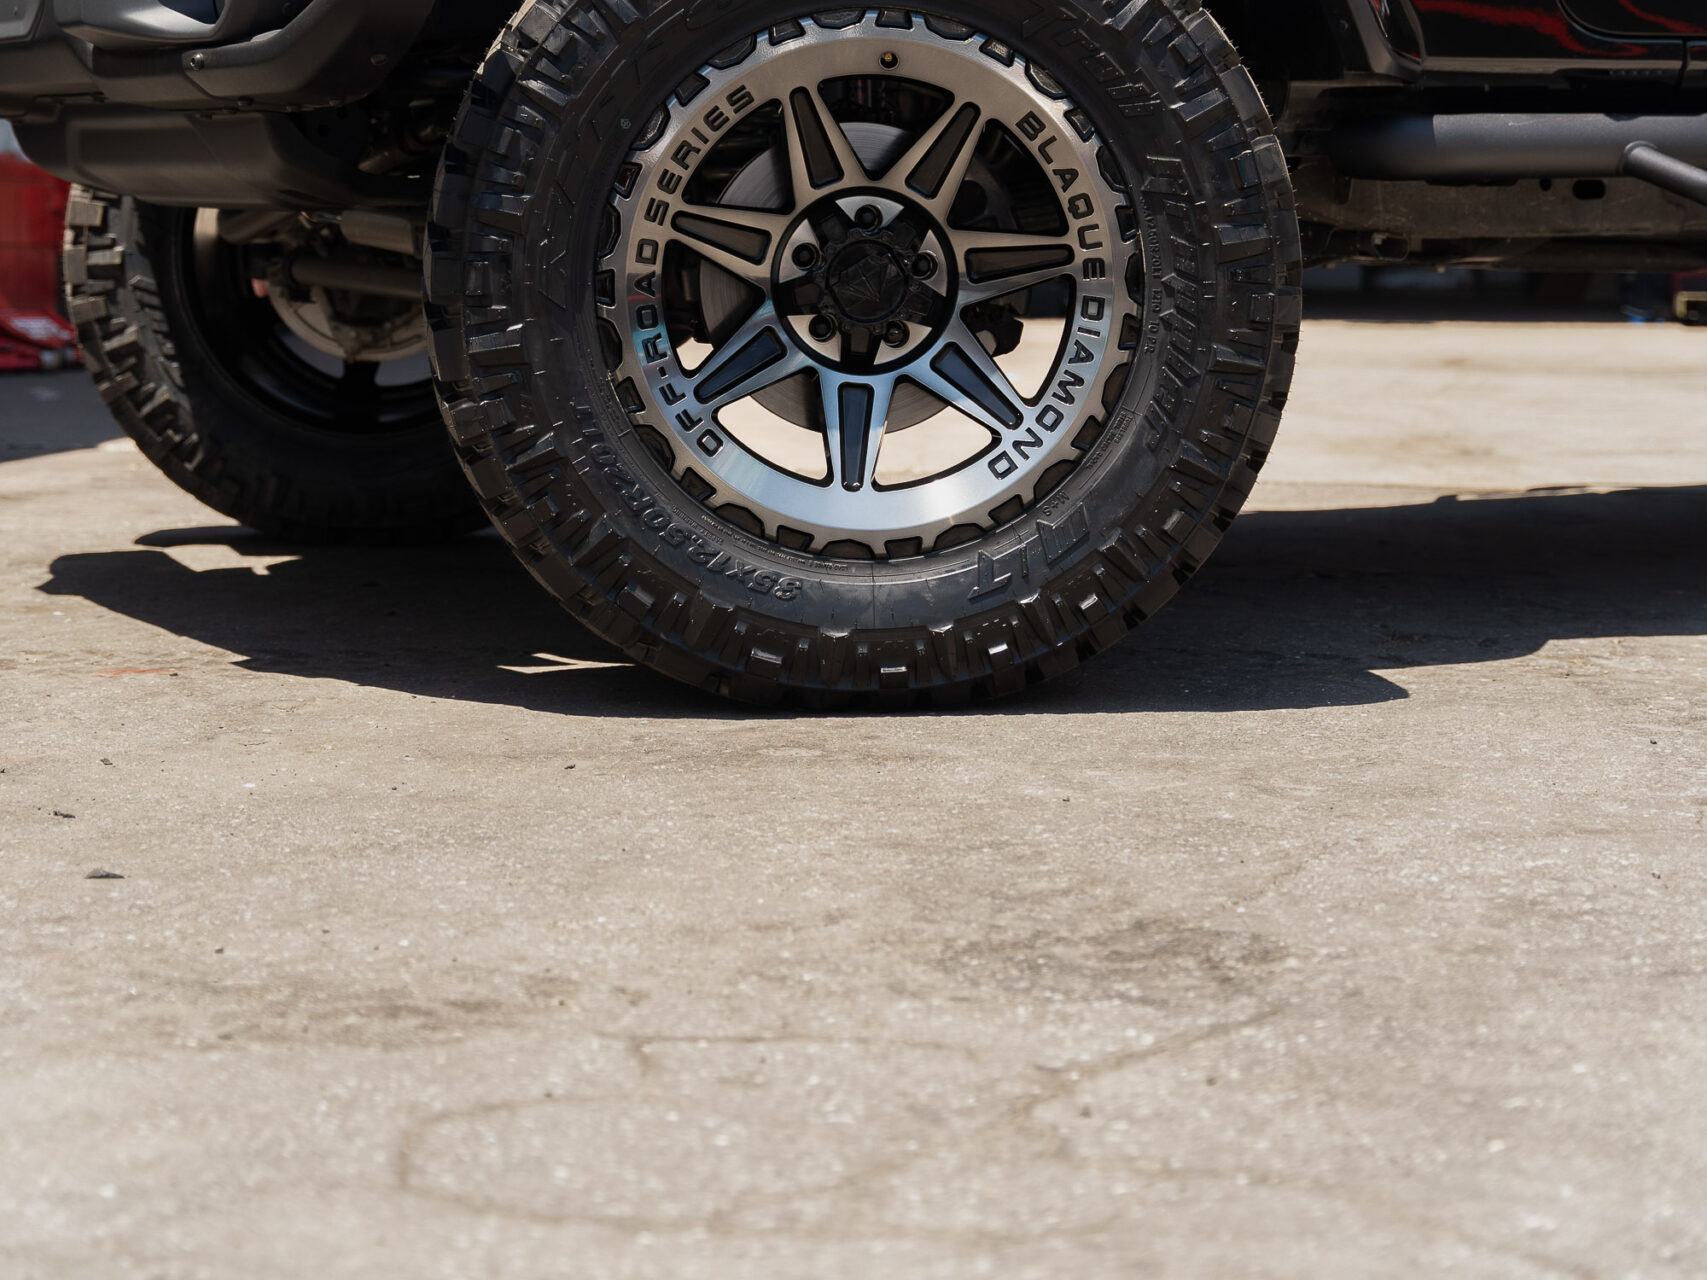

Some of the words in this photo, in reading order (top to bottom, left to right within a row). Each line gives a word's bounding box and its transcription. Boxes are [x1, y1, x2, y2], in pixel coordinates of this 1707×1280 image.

[644, 84, 756, 226] SERIES
[1015, 109, 1106, 283] BLAQUE
[634, 238, 724, 458] OFF-ROAD
[986, 295, 1102, 481] DIAMOND
[1041, 489, 1070, 517] M+S
